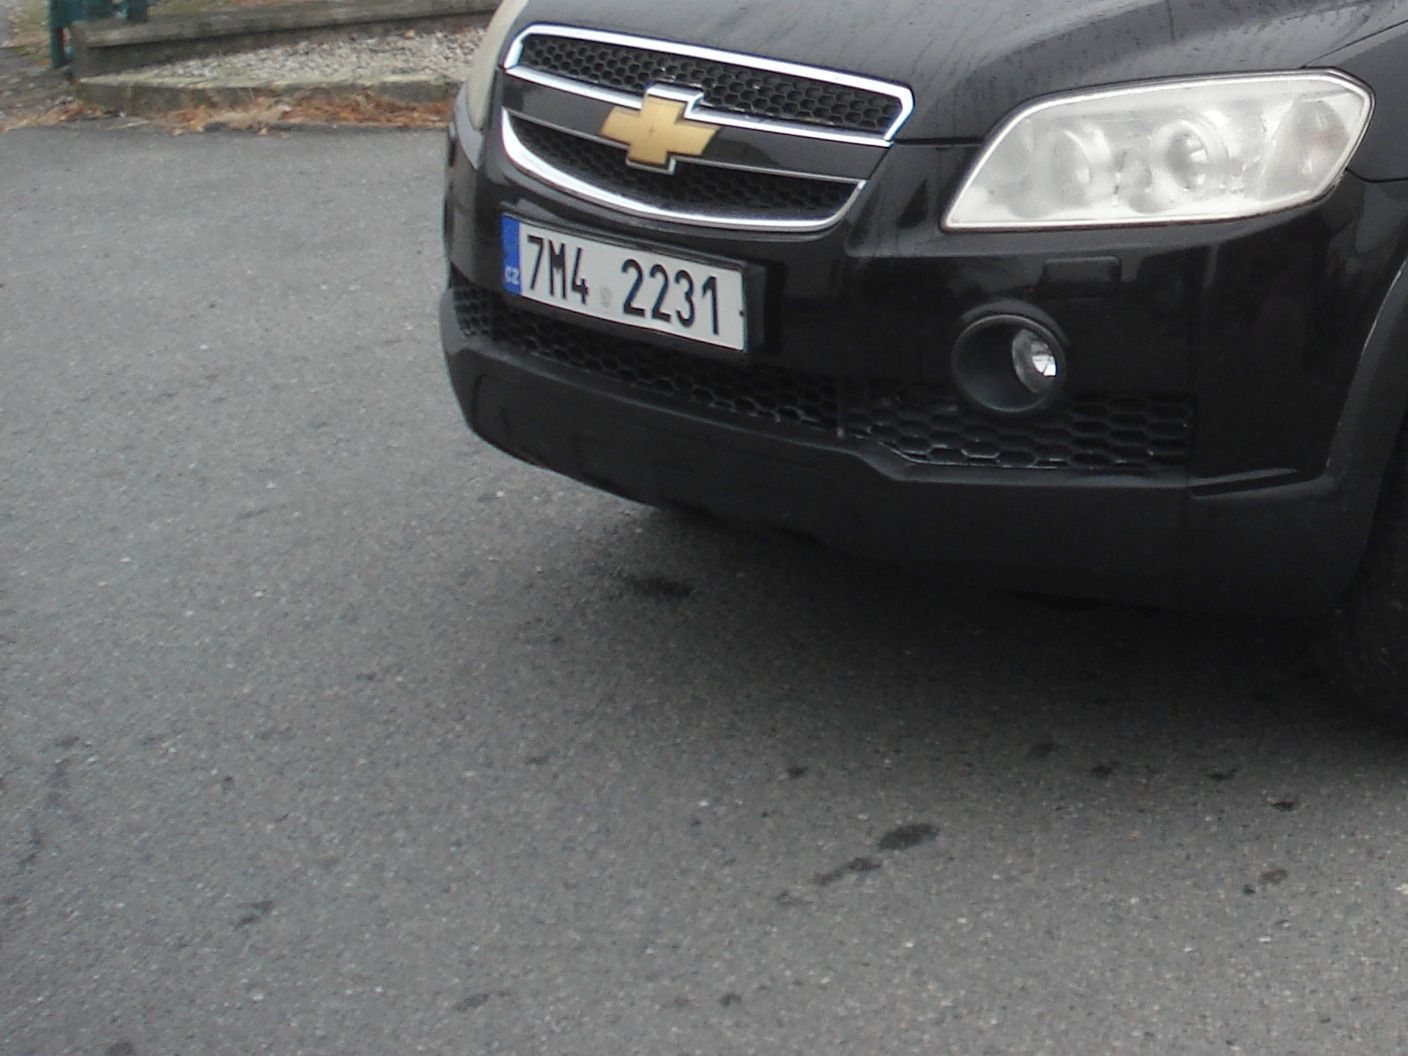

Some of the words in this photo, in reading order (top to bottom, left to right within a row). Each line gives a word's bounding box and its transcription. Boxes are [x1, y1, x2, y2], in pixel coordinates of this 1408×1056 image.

[505, 266, 520, 285] CZ
[526, 234, 590, 305] 7M4
[621, 258, 719, 336] 2231
